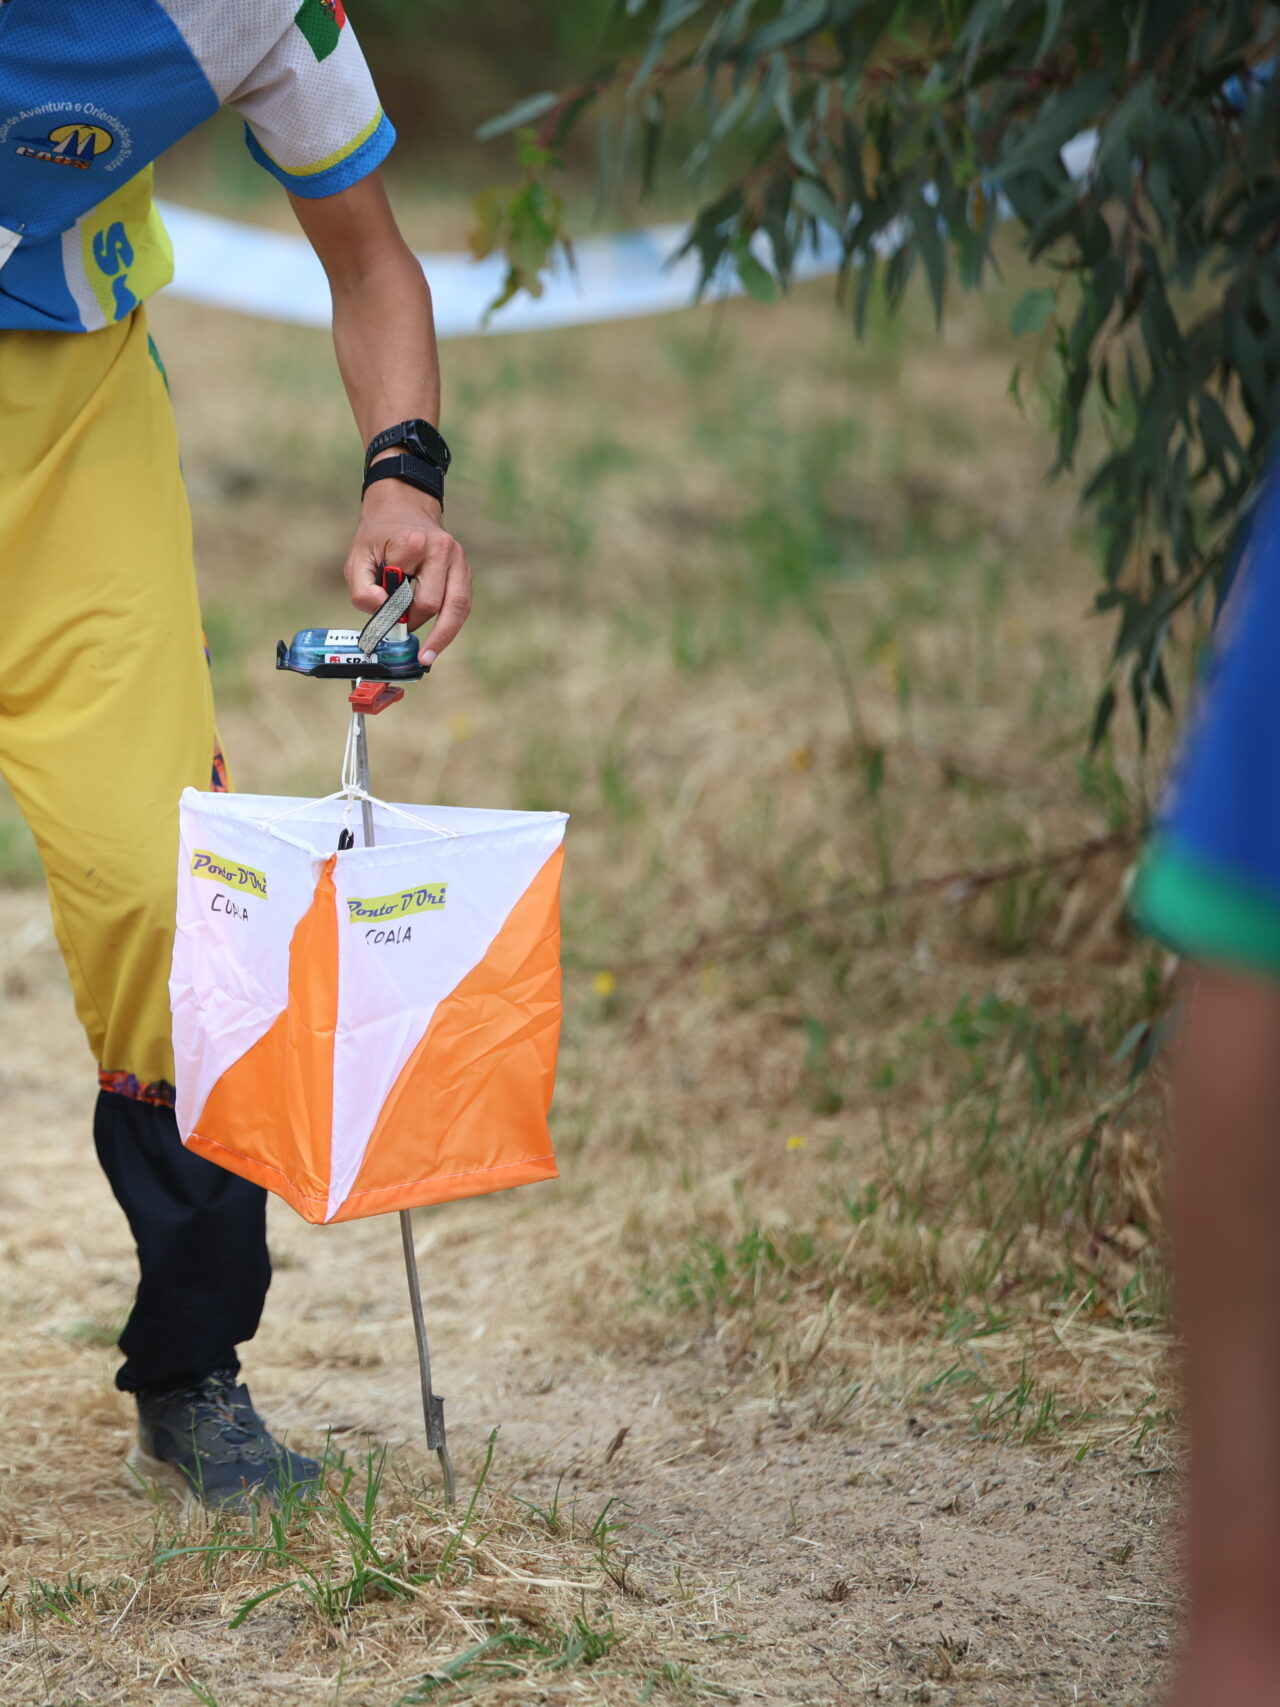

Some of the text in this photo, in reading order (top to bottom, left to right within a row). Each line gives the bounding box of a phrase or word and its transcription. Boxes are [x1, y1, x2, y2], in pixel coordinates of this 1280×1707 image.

[20, 101, 73, 120] Aventura
[347, 887, 447, 918] Ponto D'Ori
